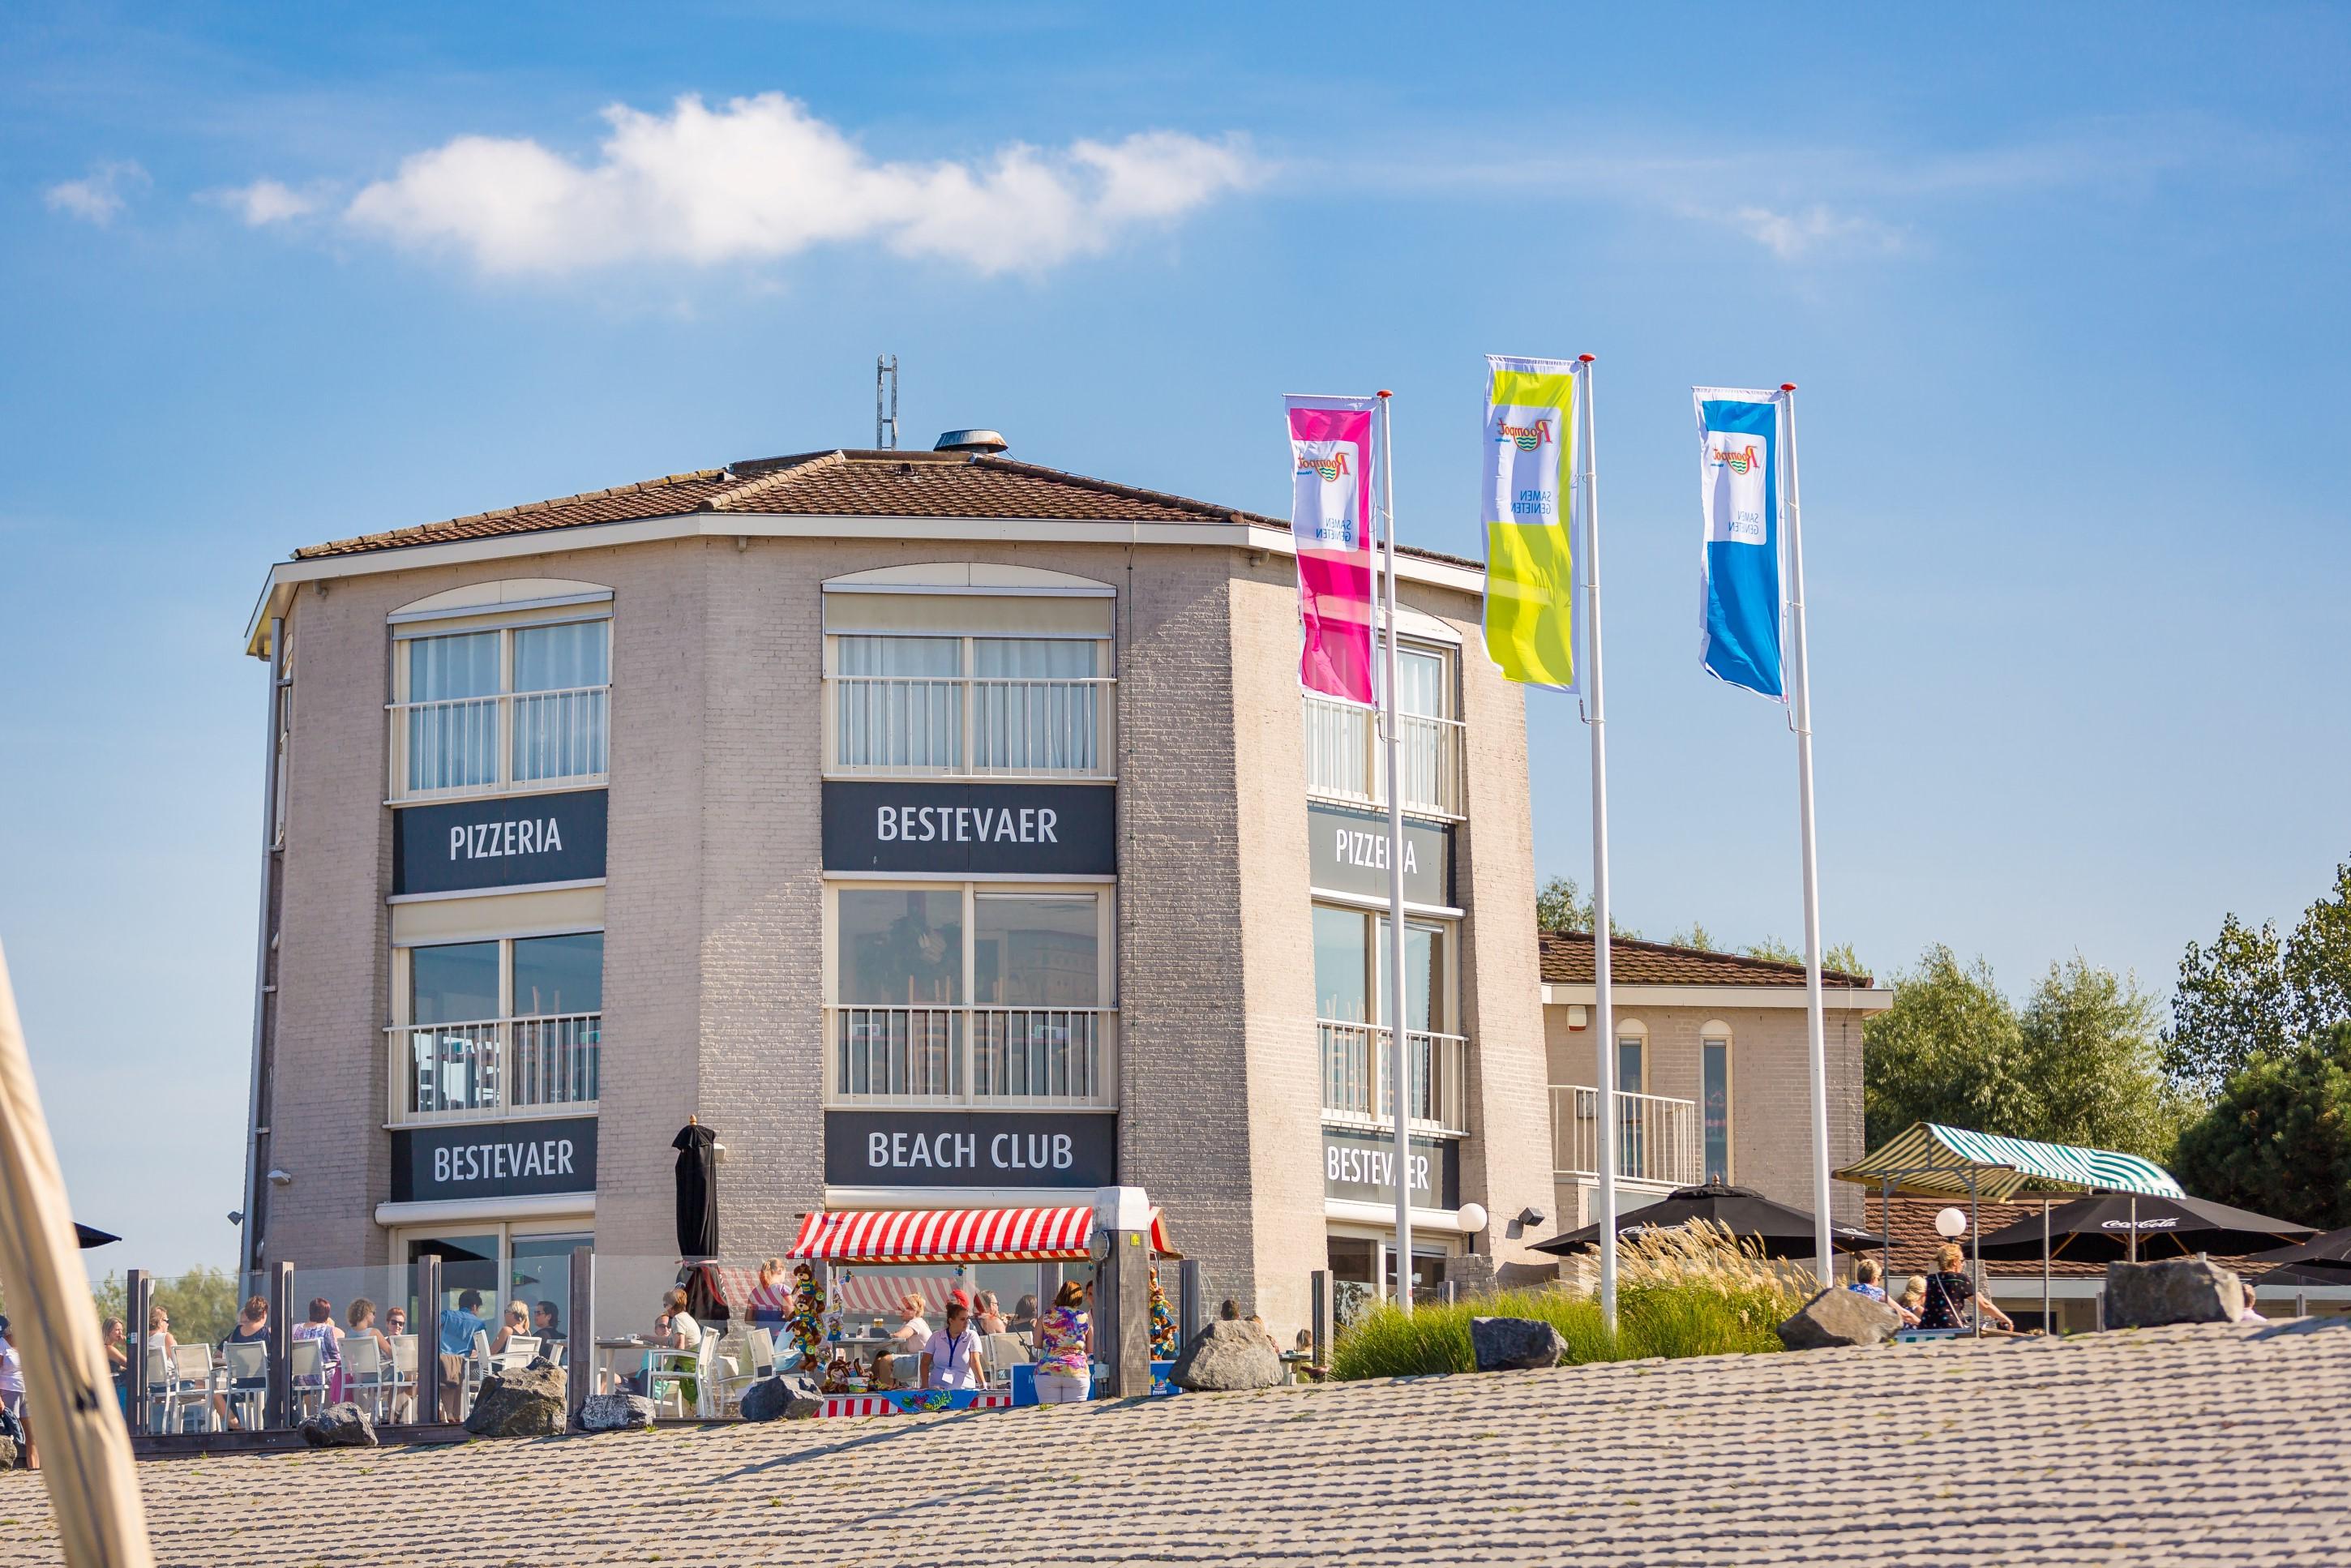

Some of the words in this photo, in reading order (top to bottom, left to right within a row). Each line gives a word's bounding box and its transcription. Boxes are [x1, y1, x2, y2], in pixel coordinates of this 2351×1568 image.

[450, 817, 563, 860] PIZZERIA
[877, 806, 1058, 843] BESTEVAER
[1336, 829, 1417, 874] PIZZEA
[435, 1139, 574, 1182] BESTEVAER
[868, 1132, 975, 1167] BEACH
[991, 1132, 1073, 1169] CLUB
[1327, 1146, 1429, 1190] BESTEVER
